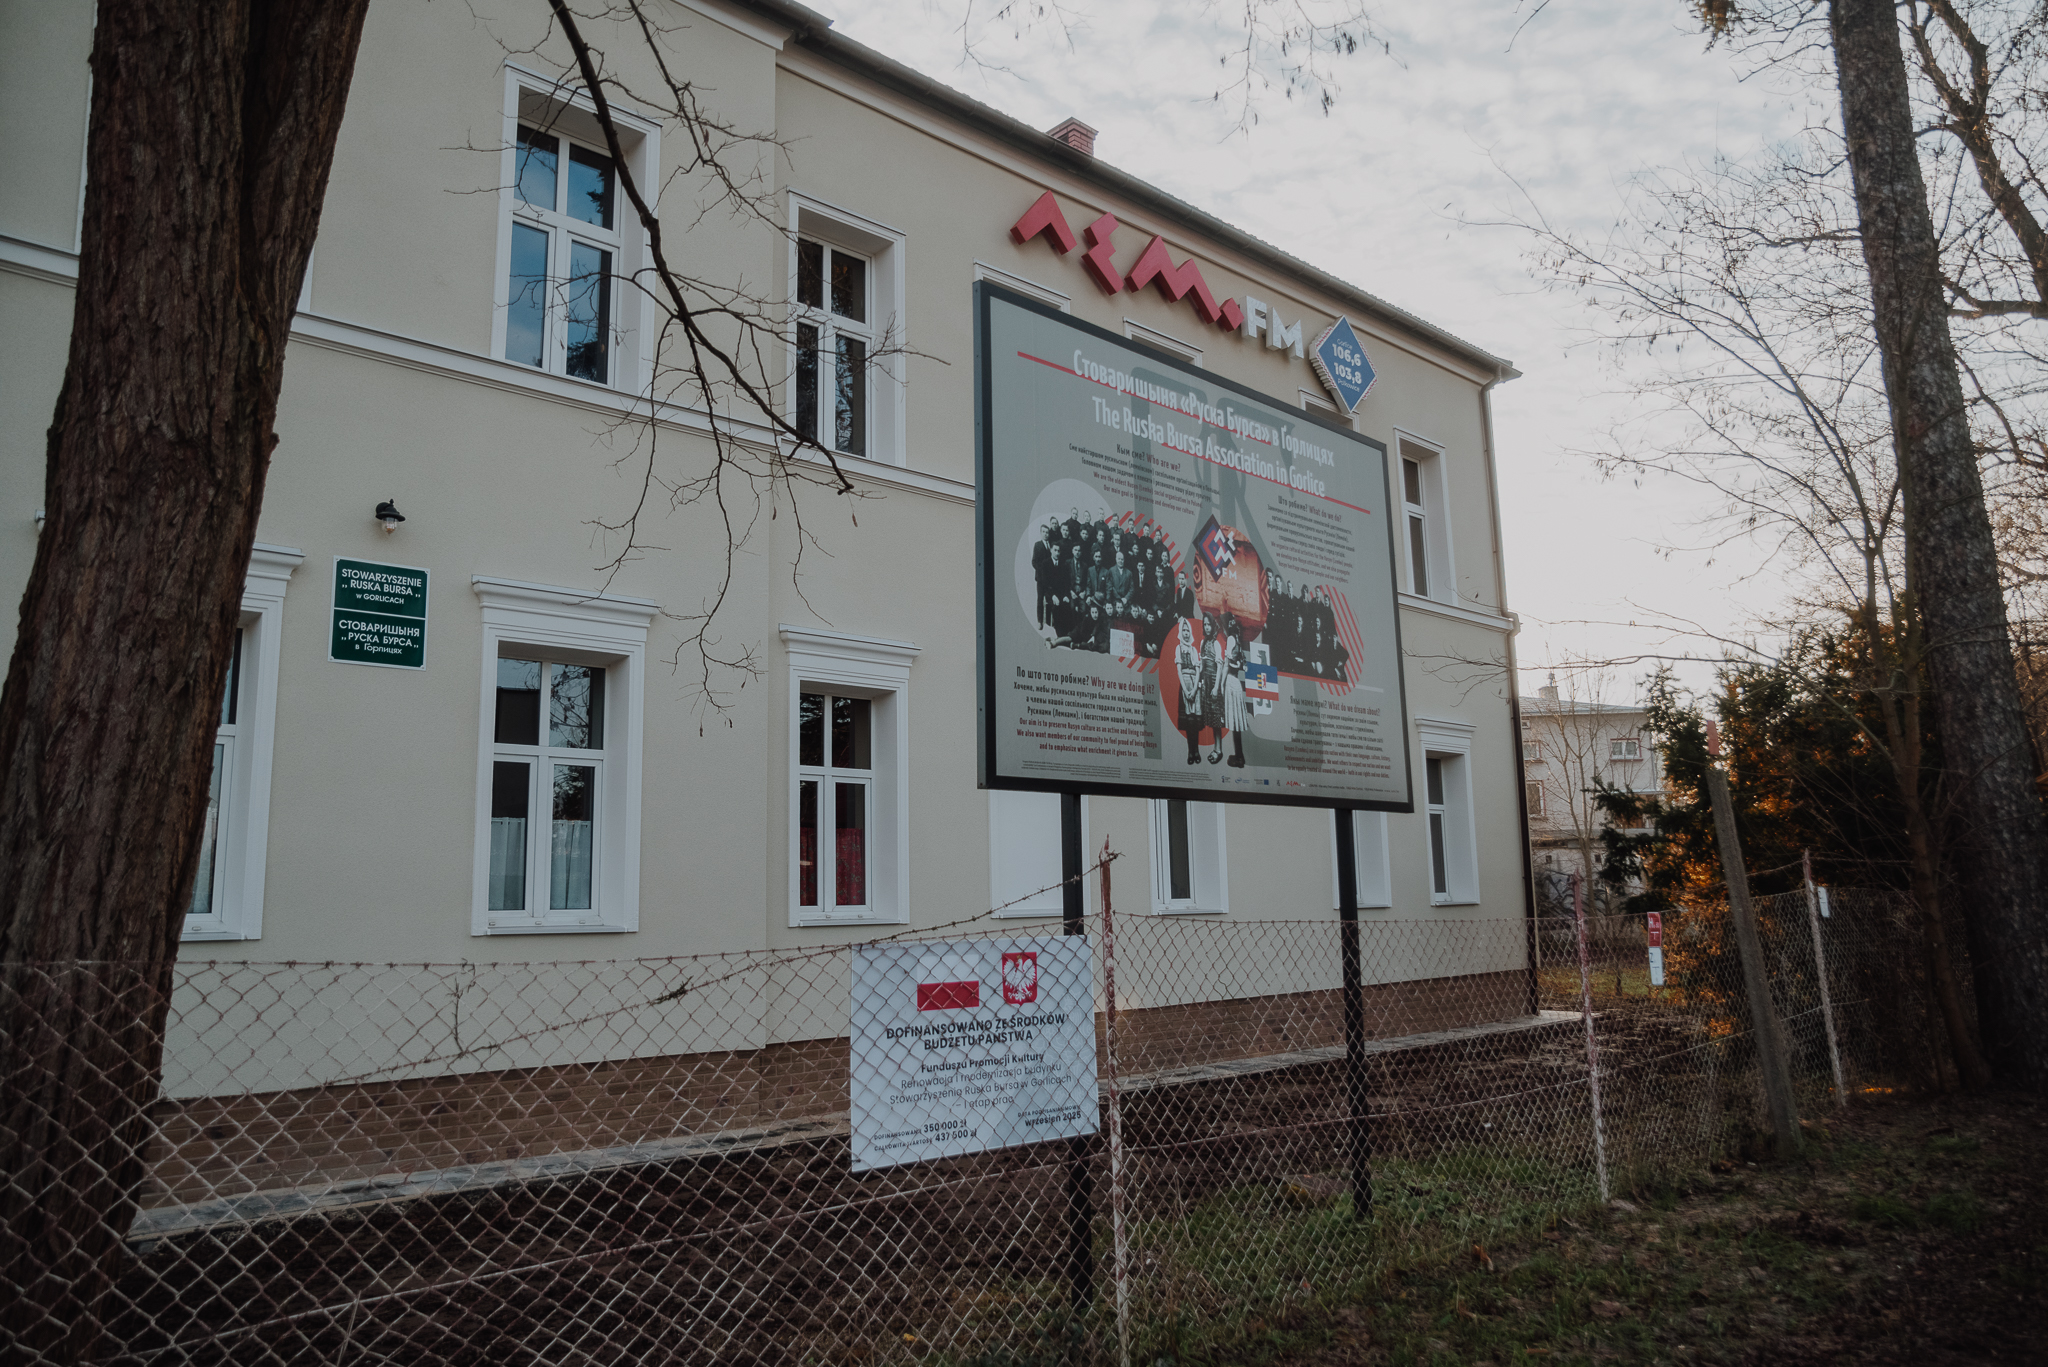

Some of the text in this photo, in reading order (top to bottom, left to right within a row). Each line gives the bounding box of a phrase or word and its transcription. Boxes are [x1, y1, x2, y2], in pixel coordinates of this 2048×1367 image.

[1332, 343, 1361, 366] 106,6
[1334, 362, 1362, 384] 103,8
[1073, 348, 1334, 467] Стоваришыня «Руска Бурса» в Ґорлицях
[1092, 396, 1325, 498] The Ruska Bursa Association in Gorlice
[1117, 444, 1181, 473] Кым сме? Who are we?
[1309, 505, 1320, 516] What
[1321, 509, 1326, 518] do
[1328, 513, 1334, 521] we
[1334, 513, 1342, 523] do?
[342, 568, 422, 587] STOWARZYSZENIE
[363, 593, 405, 604] GORLICACH
[339, 619, 420, 637] СТОВАРИШЫНЯ
[1017, 666, 1155, 695] По што тото робиме? Why are we doing it?
[1077, 691, 1097, 701] культура
[1328, 701, 1340, 711] What
[1341, 703, 1346, 712] do
[1354, 704, 1366, 715] dream
[1366, 707, 1381, 717] about?
[1019, 717, 1027, 725] Our
[1029, 718, 1037, 726] aim
[1049, 721, 1067, 730] preserve
[1068, 722, 1080, 731] Rusyn
[1081, 724, 1095, 732] culture
[1128, 728, 1139, 737] living
[1140, 730, 1154, 738] culture.
[1025, 729, 1034, 737] also
[1035, 730, 1047, 738] want
[1047, 731, 1067, 740] members
[1081, 735, 1103, 744] community
[1118, 738, 1129, 747] proud
[1135, 740, 1145, 748] being
[1054, 743, 1076, 753] emphasize
[1077, 745, 1088, 753] what
[1088, 746, 1111, 755] enrichment
[1116, 749, 1127, 758] gives
[886, 1010, 1065, 1040] DOFINANSOWANO ZE ŚRODKÓW
[924, 1026, 1033, 1050] BUDŻETU PAŃSTWA
[921, 1051, 1044, 1073] Funduszu Promocji Kultury
[901, 1074, 953, 1092] Renowacja
[961, 1066, 1022, 1084] modernizacja
[1025, 1062, 1061, 1077] budynku
[965, 1083, 991, 1095] Ruska
[994, 1080, 1019, 1092] Bursa
[1031, 1073, 1071, 1087] Gorlicach
[970, 1098, 990, 1111] etap
[992, 1095, 1013, 1107] prac
[1063, 1110, 1081, 1121] 2025
[924, 1122, 939, 1133] 350
[941, 1120, 958, 1130] 000
[935, 1132, 950, 1142] 437
[953, 1129, 968, 1139] 500
